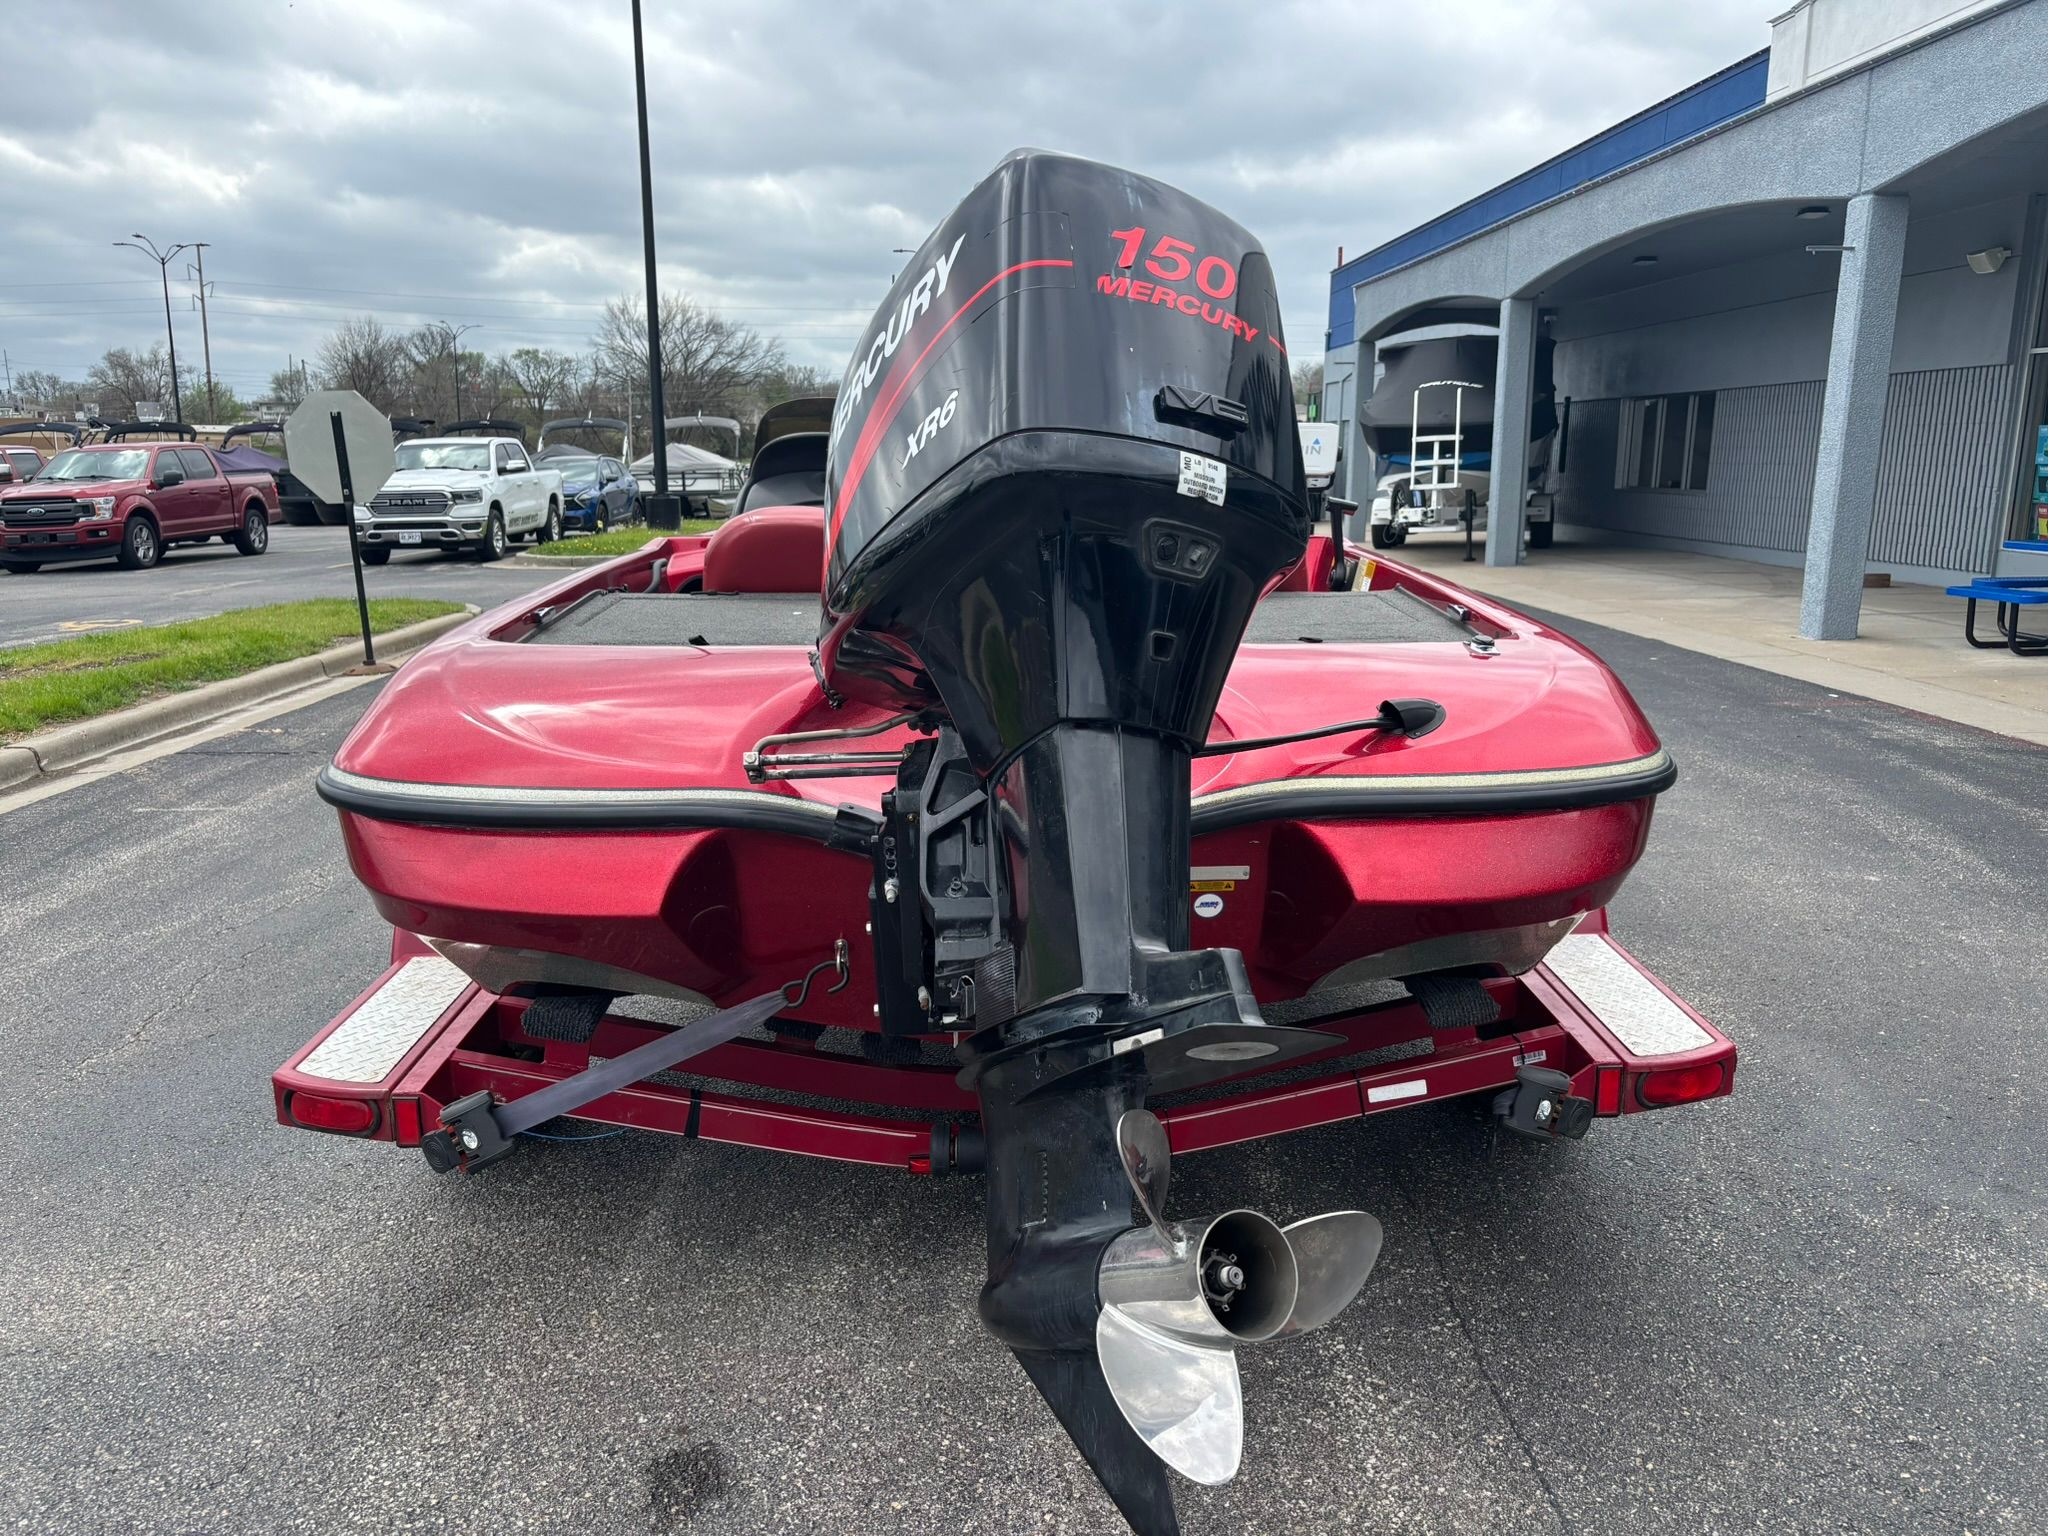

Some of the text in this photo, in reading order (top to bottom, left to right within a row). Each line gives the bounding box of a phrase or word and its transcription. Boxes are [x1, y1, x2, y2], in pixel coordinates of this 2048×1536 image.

[1111, 226, 1236, 299] 150
[1097, 273, 1259, 343] MERCURY
[1165, 385, 1249, 424] V6
[901, 389, 959, 471] XR6
[1183, 456, 1192, 471] MO
[1183, 477, 1224, 495] OUTBOARD MOTOR
[1193, 472, 1216, 484] MISSOURI
[1186, 486, 1219, 501] REGISTRATION
